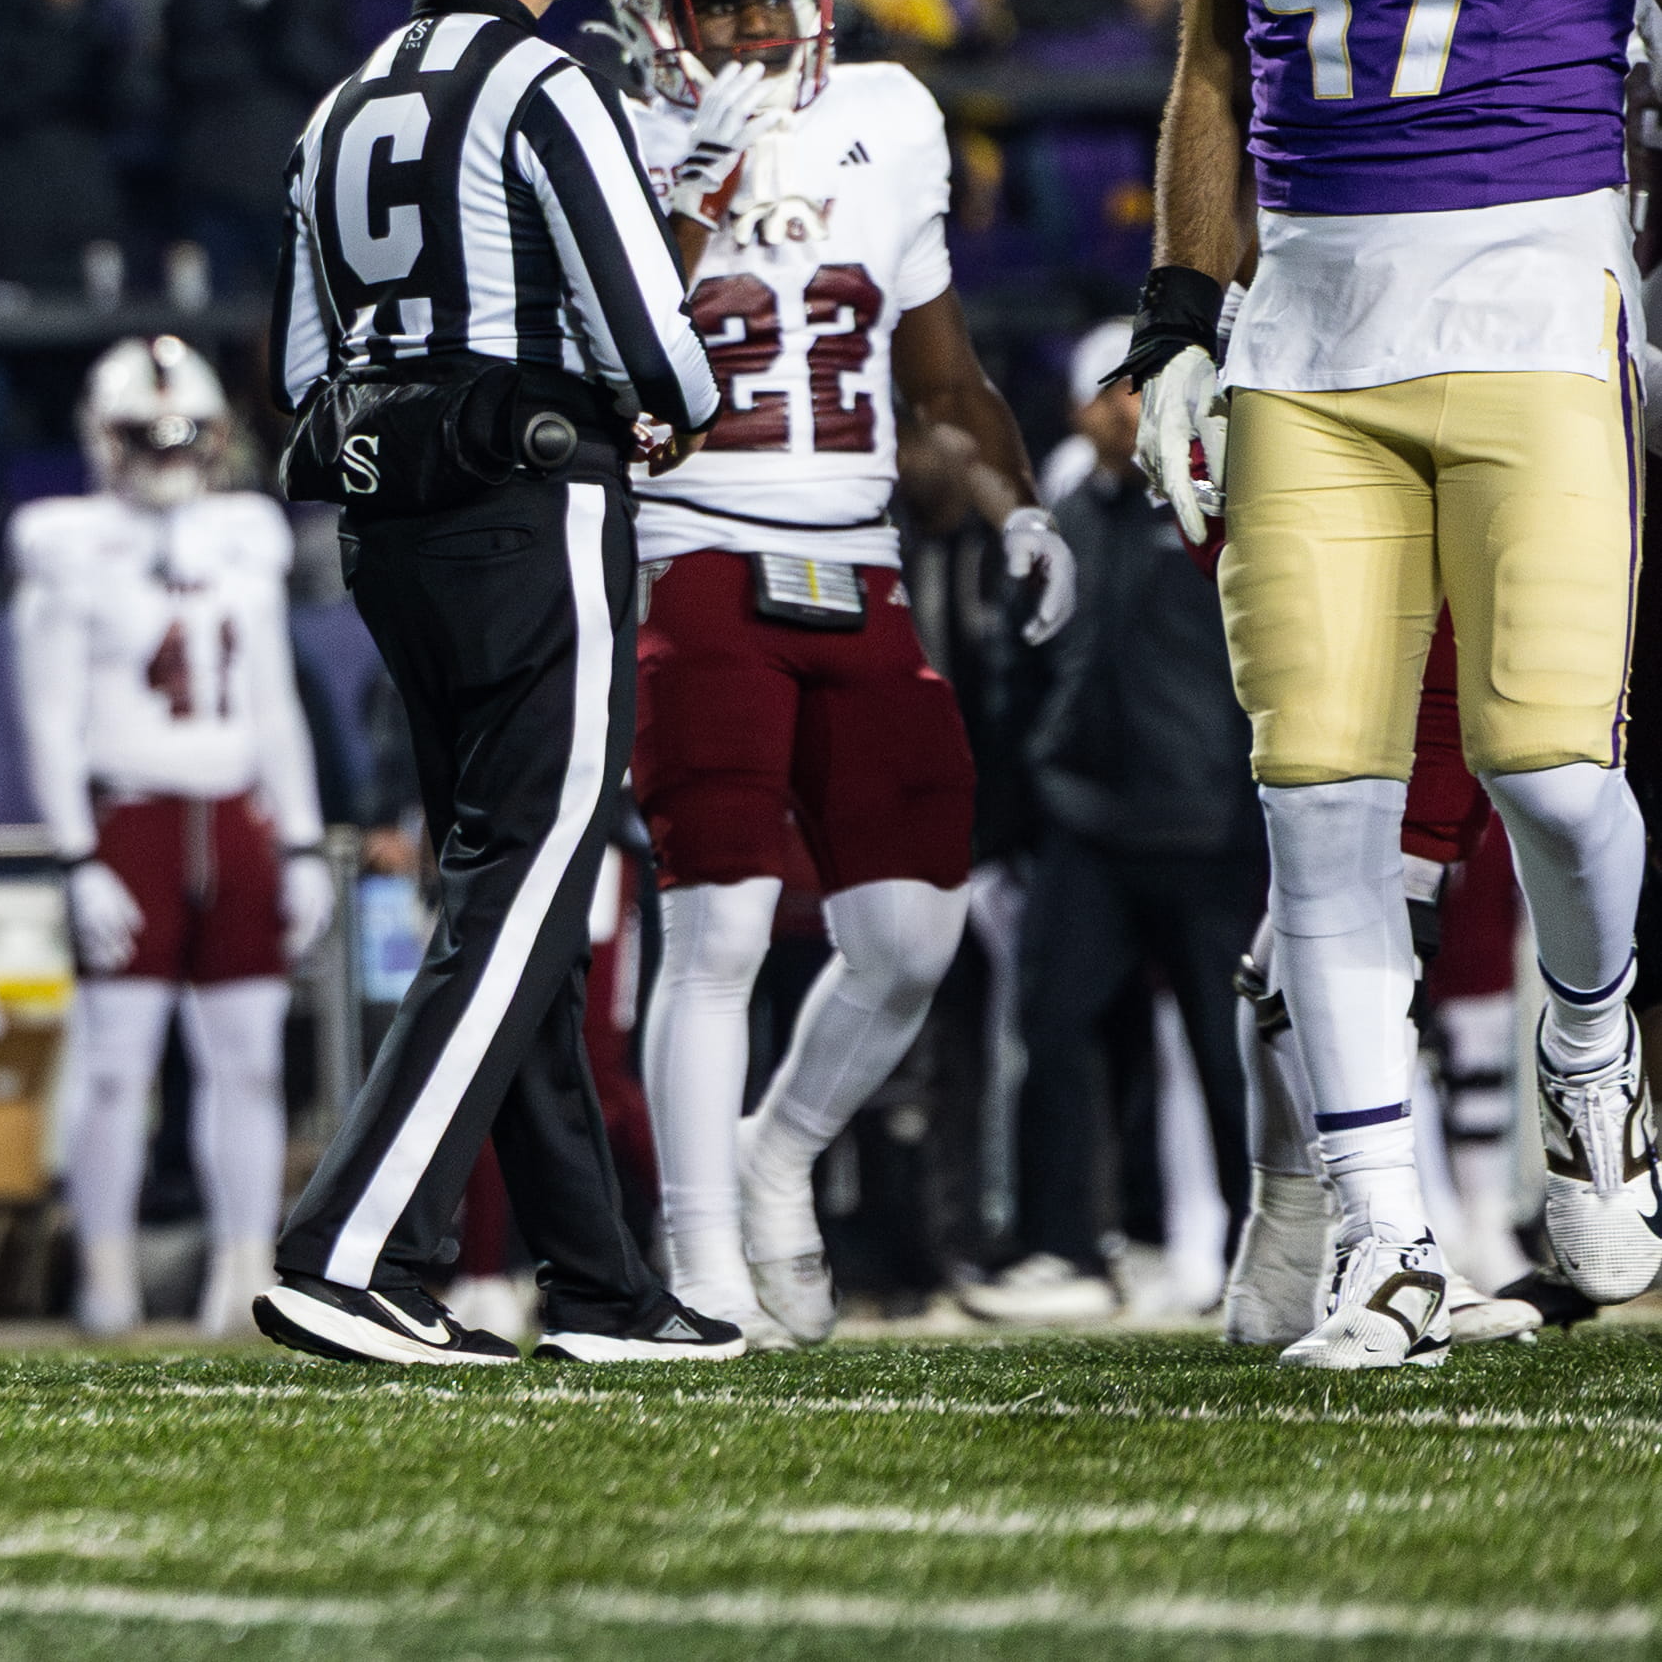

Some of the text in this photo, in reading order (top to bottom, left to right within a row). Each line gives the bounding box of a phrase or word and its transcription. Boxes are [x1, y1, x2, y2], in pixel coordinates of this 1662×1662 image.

[335, 92, 431, 285] C
[688, 263, 884, 453] 22
[342, 435, 380, 494] S
[144, 615, 237, 722] 41
